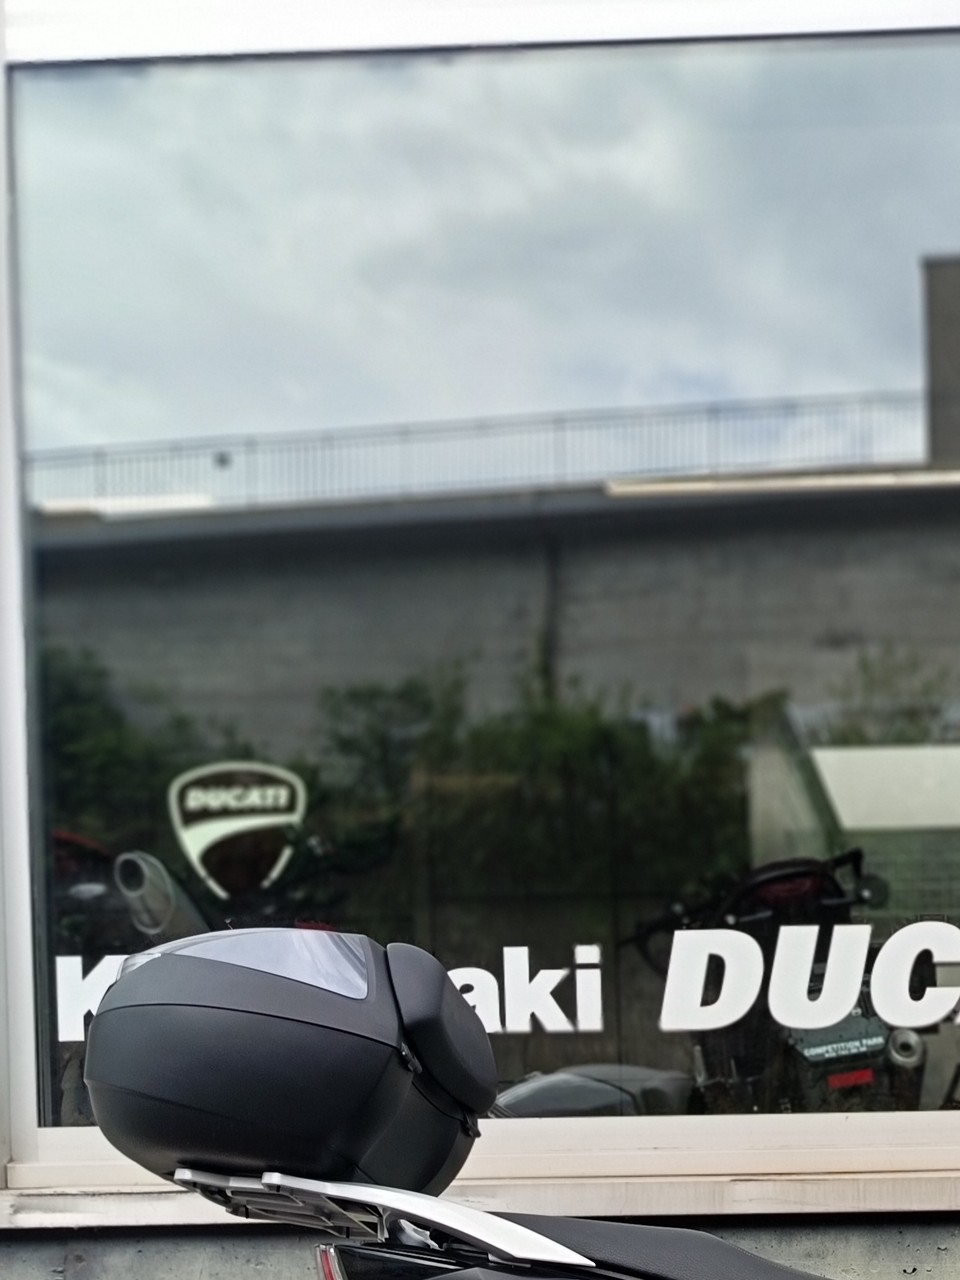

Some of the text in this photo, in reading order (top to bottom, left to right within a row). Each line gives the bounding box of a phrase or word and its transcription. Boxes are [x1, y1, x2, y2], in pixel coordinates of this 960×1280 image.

[184, 785, 289, 811] DUCATI
[803, 1040, 861, 1057] COMPETITION
[862, 1035, 885, 1049] PARK
